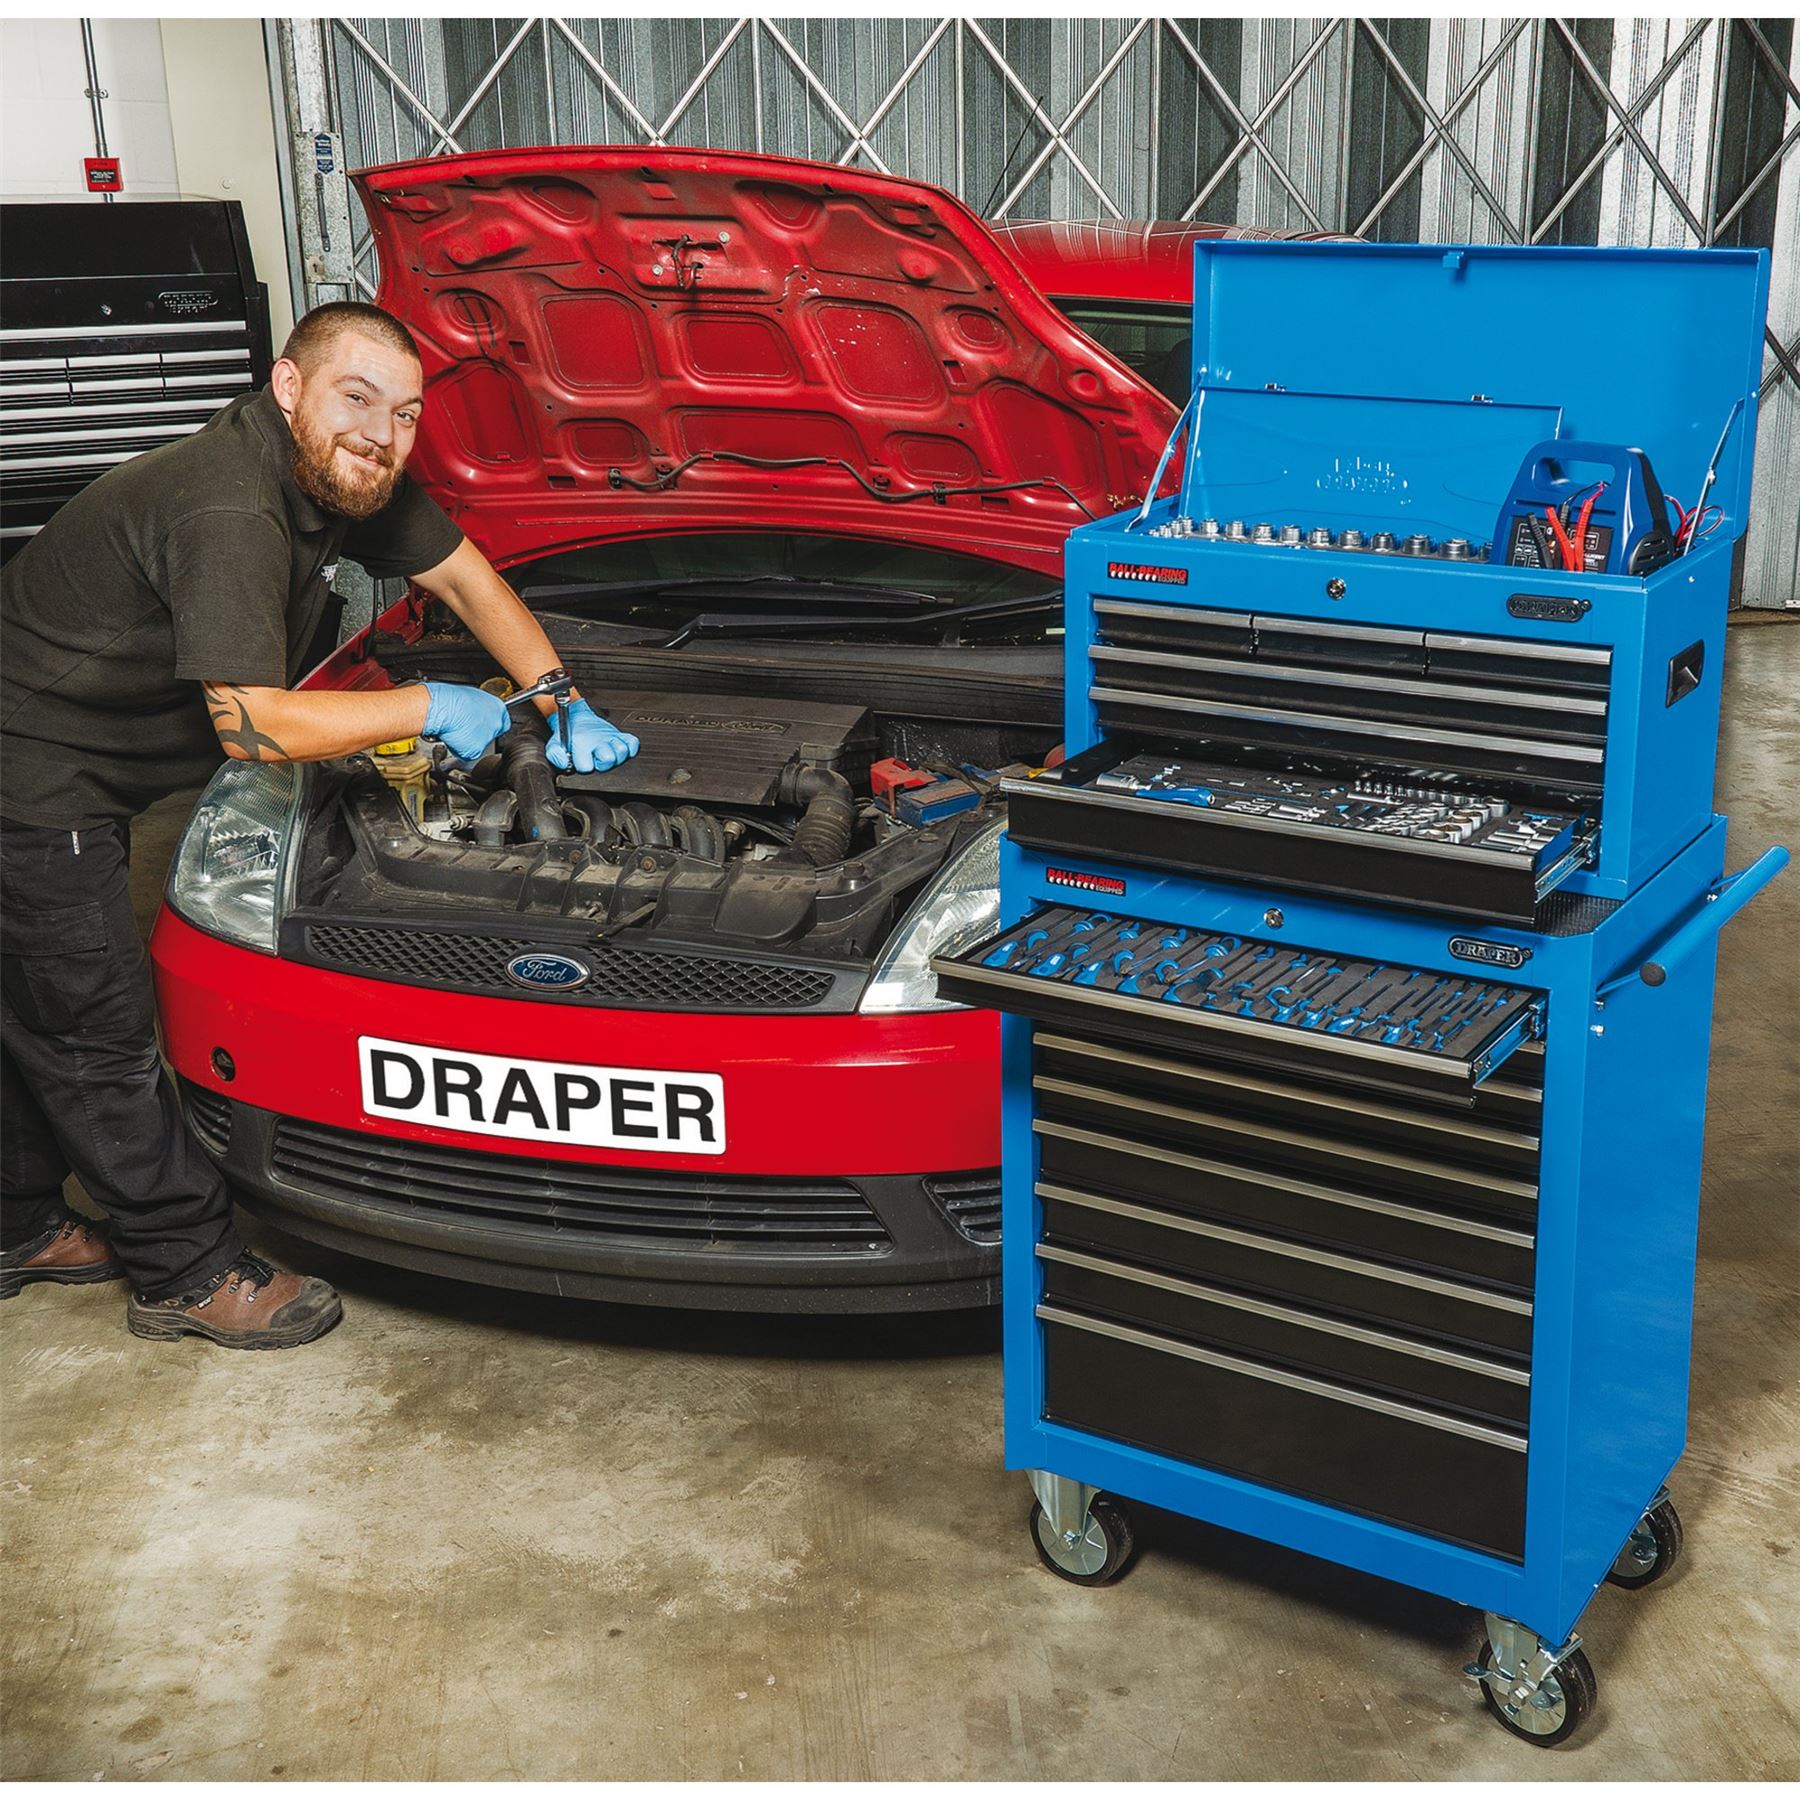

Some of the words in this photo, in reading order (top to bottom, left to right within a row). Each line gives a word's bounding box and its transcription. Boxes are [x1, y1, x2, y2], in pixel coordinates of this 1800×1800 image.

[1109, 563, 1187, 579] BALL-BEARING
[1047, 869, 1124, 889] BALL-BEARING
[1456, 942, 1517, 963] DRAPER
[522, 960, 568, 981] Ford
[370, 1049, 716, 1142] DRAPER
